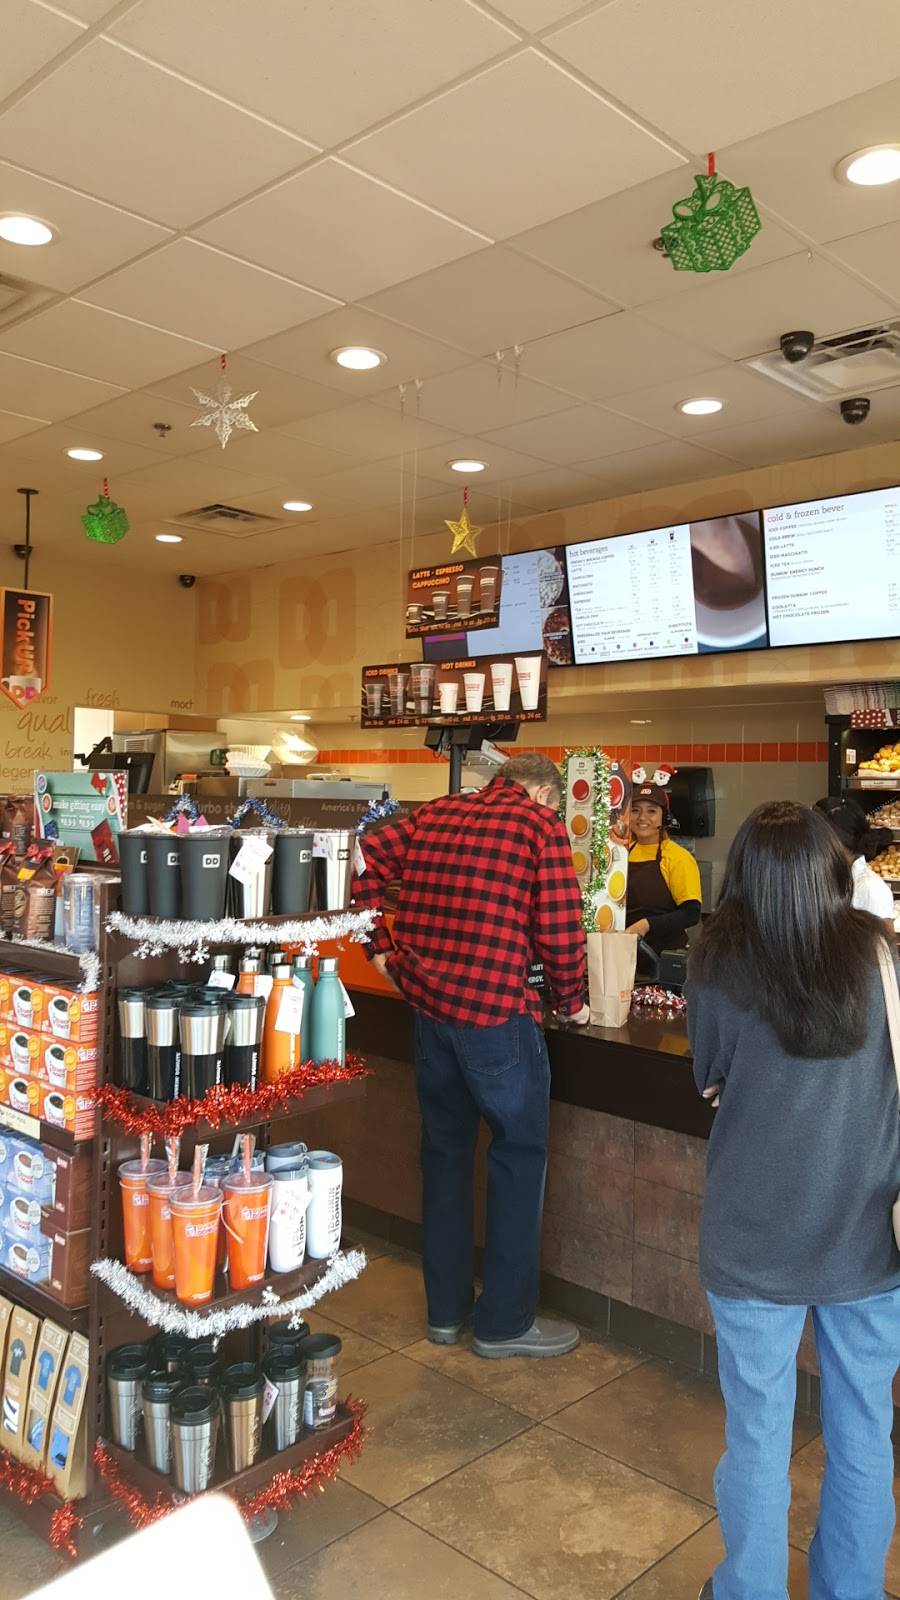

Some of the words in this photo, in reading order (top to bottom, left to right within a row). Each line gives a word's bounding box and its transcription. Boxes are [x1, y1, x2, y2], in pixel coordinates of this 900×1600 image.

[768, 513, 784, 523] cold
[786, 512, 792, 520] &
[794, 509, 820, 519] frozen
[822, 504, 845, 514] bever
[569, 550, 578, 558] hot
[579, 546, 609, 556] beverages
[412, 569, 431, 579] LATTE
[435, 564, 464, 575] ESPRESSO
[412, 577, 450, 589] CAPPUCCINO
[441, 662, 454, 670] HOT
[86, 687, 121, 707] fresh
[17, 706, 72, 743] qual
[5, 740, 52, 760] break
[205, 856, 219, 866] DD
